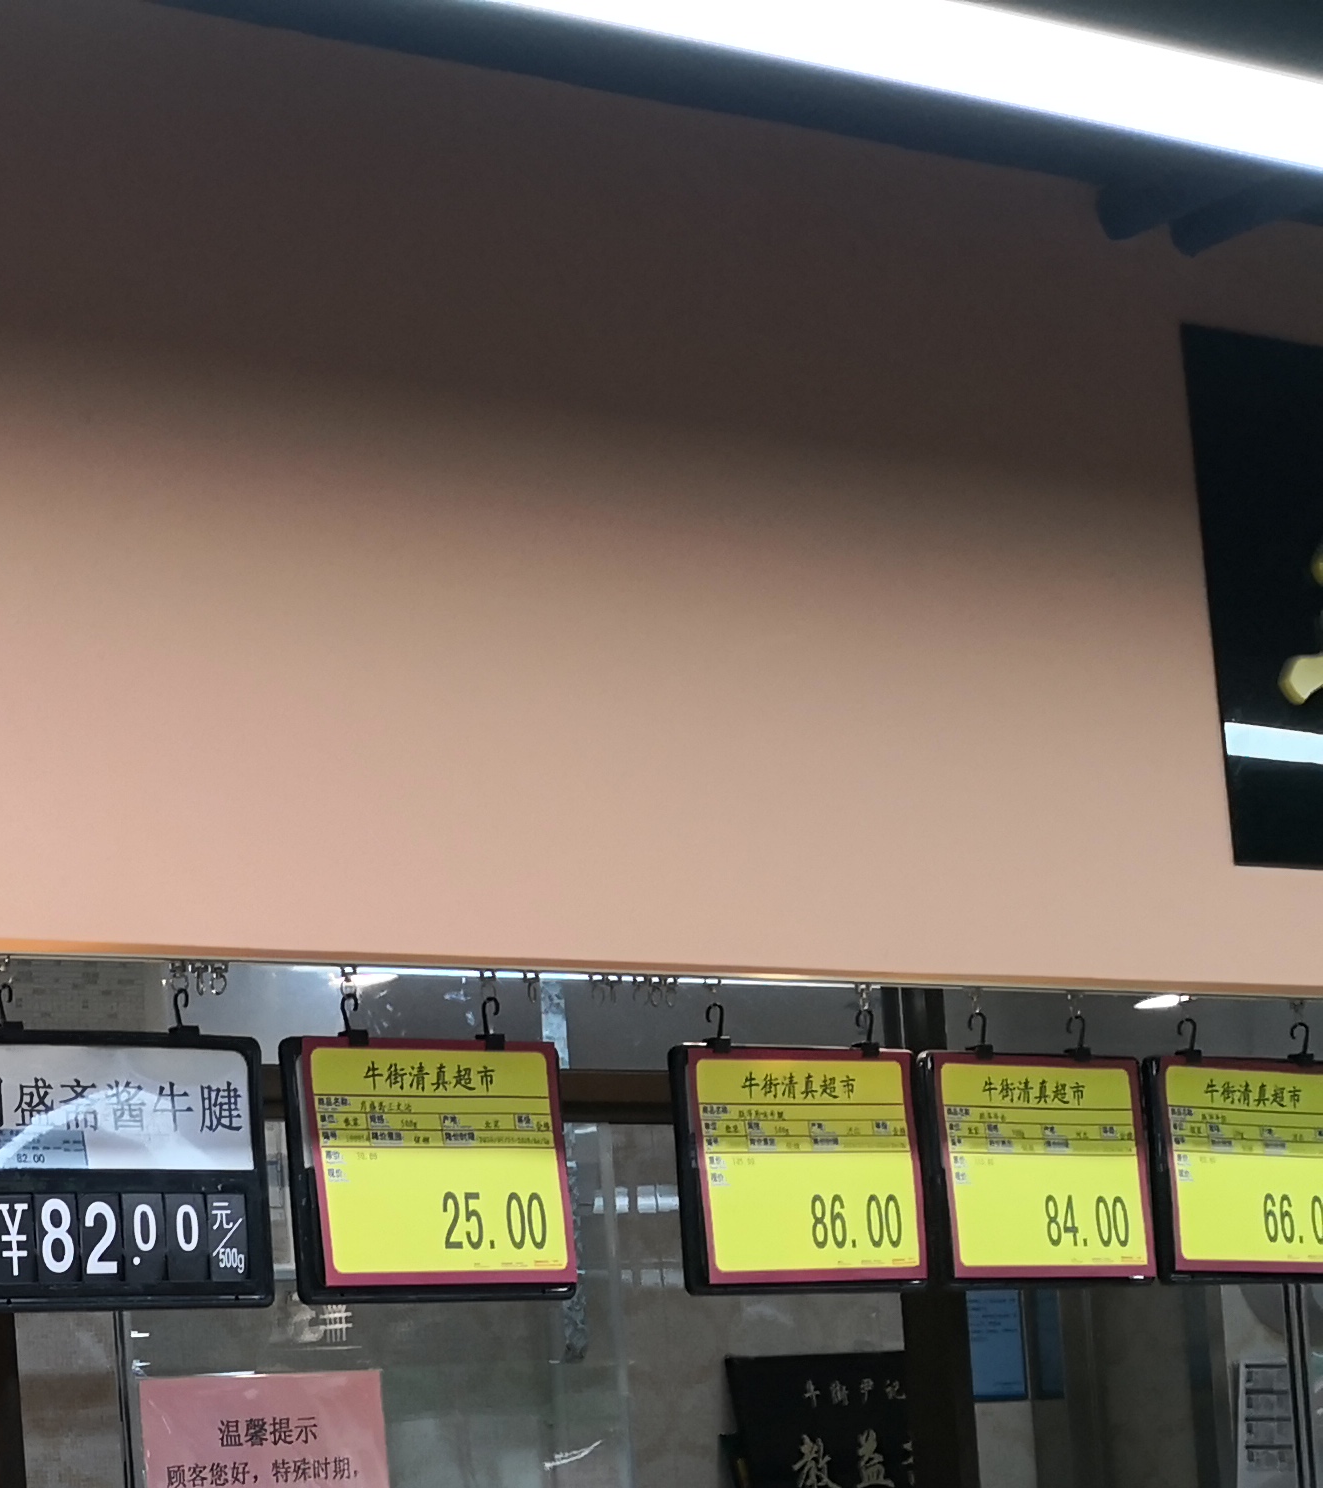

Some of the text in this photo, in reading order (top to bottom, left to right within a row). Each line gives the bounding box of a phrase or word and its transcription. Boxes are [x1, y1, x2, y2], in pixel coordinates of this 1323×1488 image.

[364, 1061, 496, 1092] 牛街清真超市
[742, 1071, 855, 1099] 牛街清真超市
[982, 1076, 1086, 1106] 牛街清真超市
[1204, 1078, 1302, 1108] 牛街清真超市
[442, 1191, 547, 1250] 25.00
[811, 1194, 902, 1249] 86.00
[1045, 1194, 1129, 1247] 84.00
[218, 1416, 318, 1447] 温馨提示
